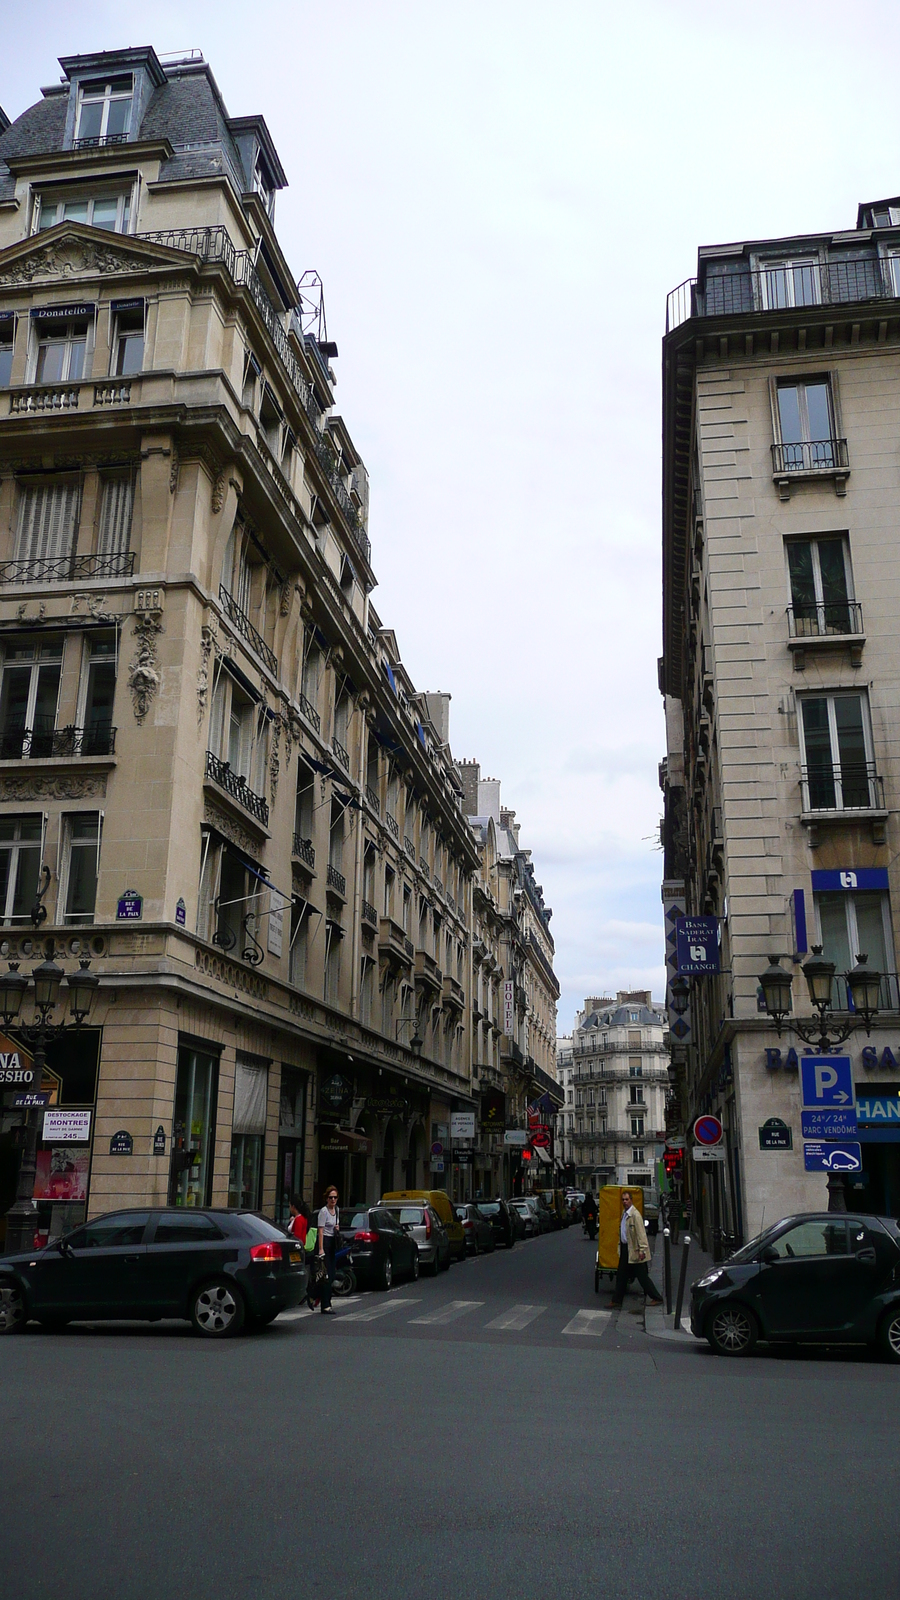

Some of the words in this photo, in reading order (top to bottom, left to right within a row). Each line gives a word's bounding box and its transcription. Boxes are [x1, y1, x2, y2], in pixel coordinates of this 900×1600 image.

[38, 306, 87, 318] Donatello
[862, 1046, 900, 1068] SA
[0, 1071, 35, 1083] ESHO
[814, 1066, 838, 1098] P
[824, 1125, 857, 1134] VENDÔME
